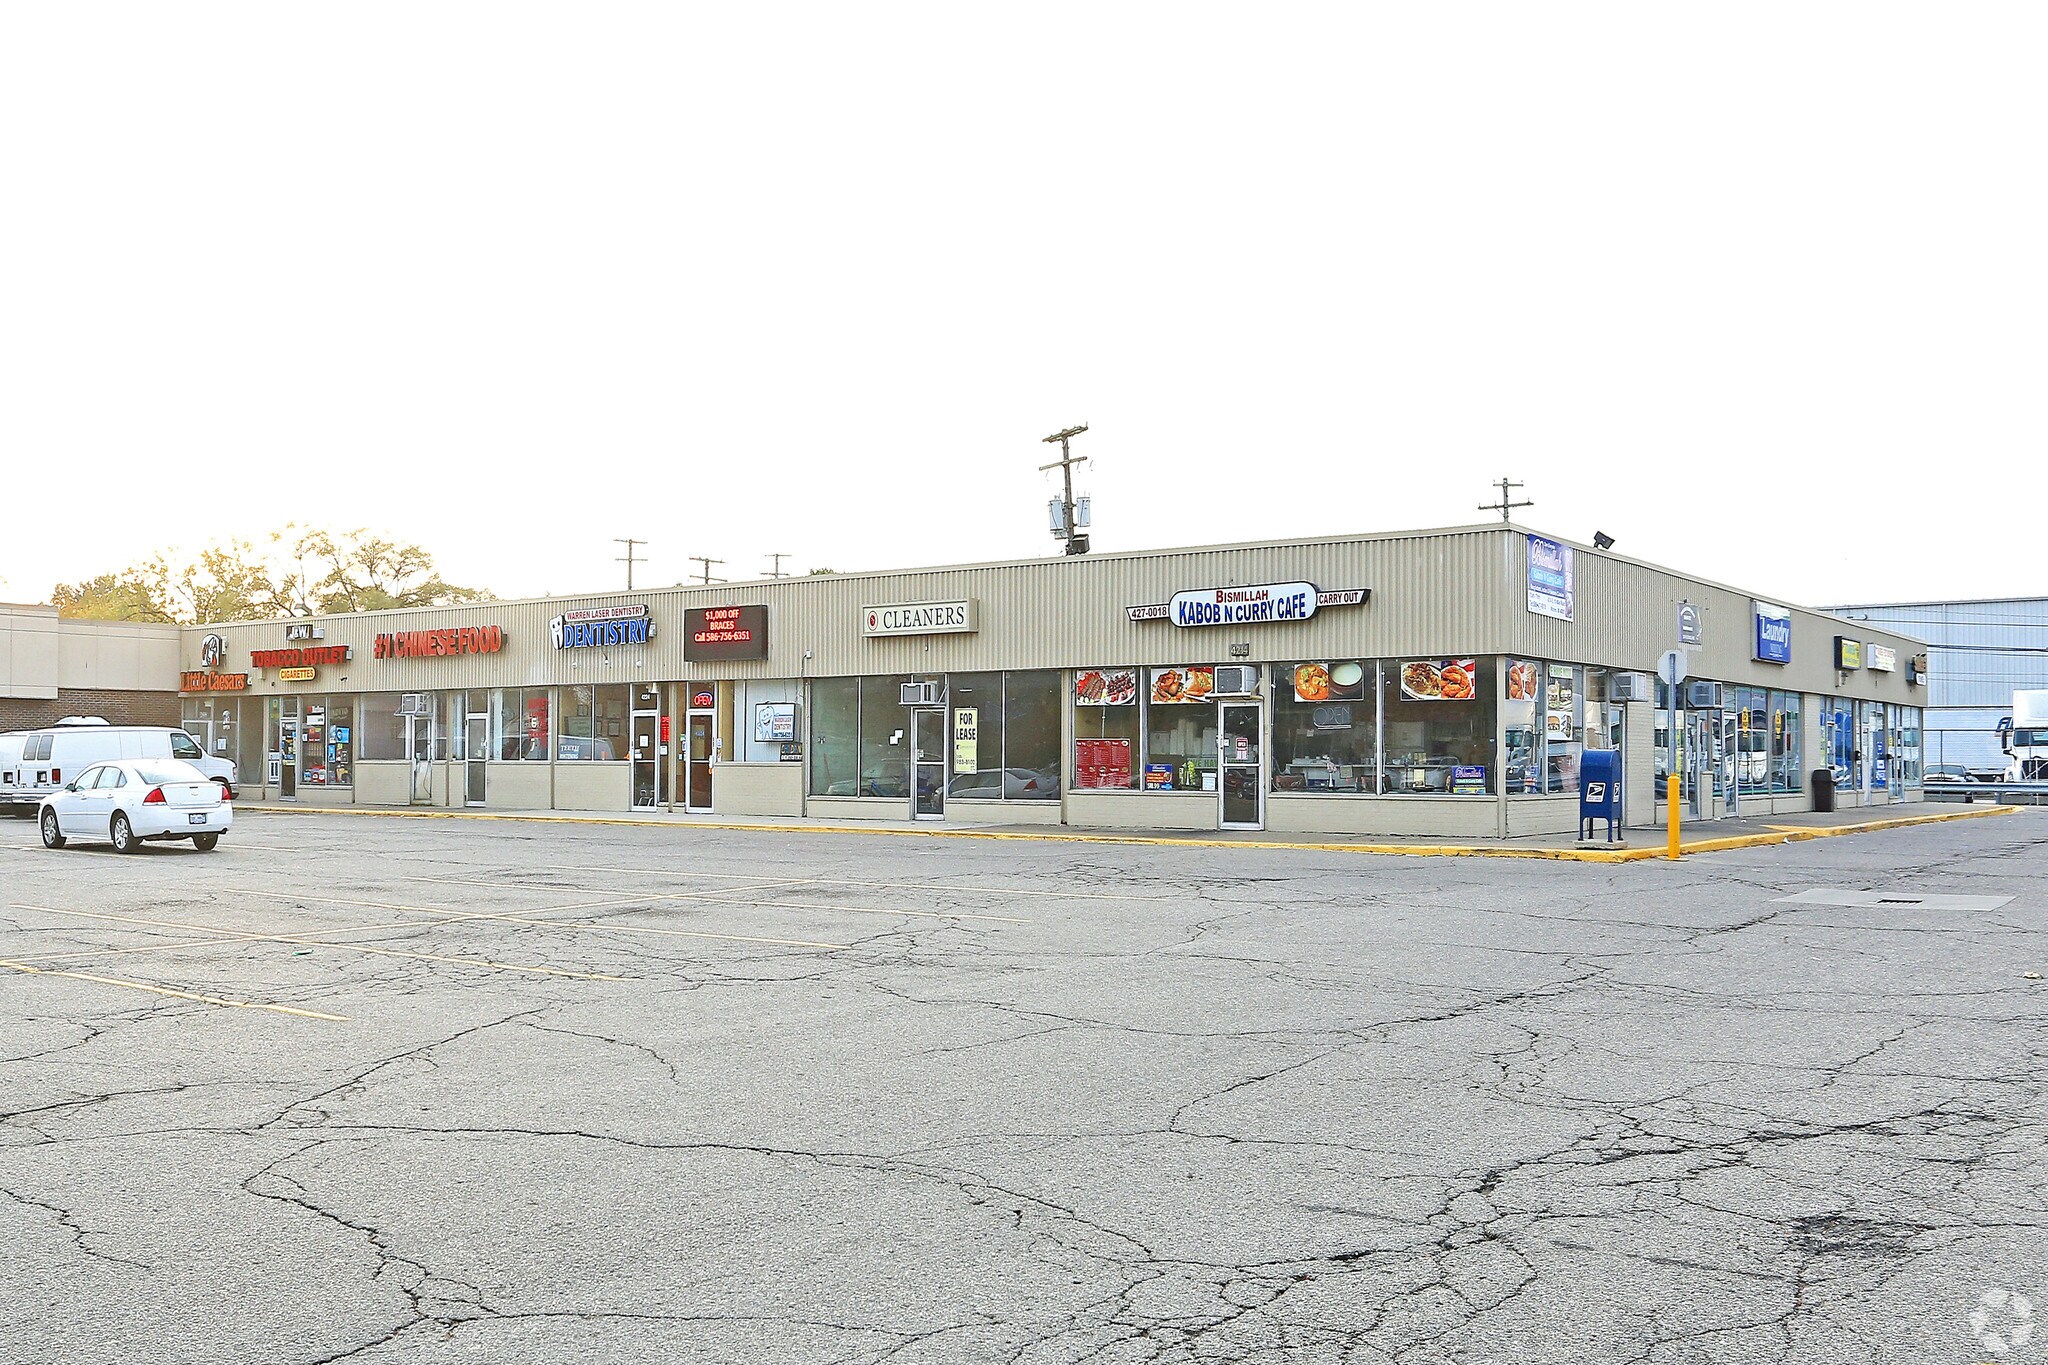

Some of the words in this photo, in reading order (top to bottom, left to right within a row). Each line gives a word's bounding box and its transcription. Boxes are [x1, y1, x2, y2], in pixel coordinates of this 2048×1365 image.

[1216, 590, 1269, 603] BISMILLAH
[1318, 593, 1341, 605] CARRY
[1343, 592, 1359, 603] OUT
[567, 610, 591, 620] WARREN
[592, 608, 610, 619] LASER
[611, 606, 643, 617] DENTISTRY
[705, 610, 727, 621] $1,000
[728, 609, 740, 619] OFF
[1131, 607, 1167, 619] 427-0018
[1179, 601, 1221, 625] KABOB
[1225, 605, 1233, 622] N
[1236, 599, 1275, 622] CURRY
[1277, 593, 1306, 619] CAFE
[883, 606, 965, 629] CLEANERS
[710, 621, 735, 631] BRACES
[1761, 617, 1790, 648] Laundry
[563, 618, 649, 649] DENTISTRY
[694, 632, 706, 642] Call
[374, 633, 392, 659] #1
[393, 628, 458, 659] CHINESE
[459, 624, 503, 654] FOOD
[251, 648, 299, 668] TOBACCO
[302, 645, 350, 666] OUTLET
[280, 668, 314, 680] CIGARETTES
[180, 671, 207, 692] Little
[208, 670, 246, 691] Caesars
[959, 713, 973, 725] FOR
[1313, 705, 1351, 725] OPEN
[956, 728, 976, 740] LEASE
